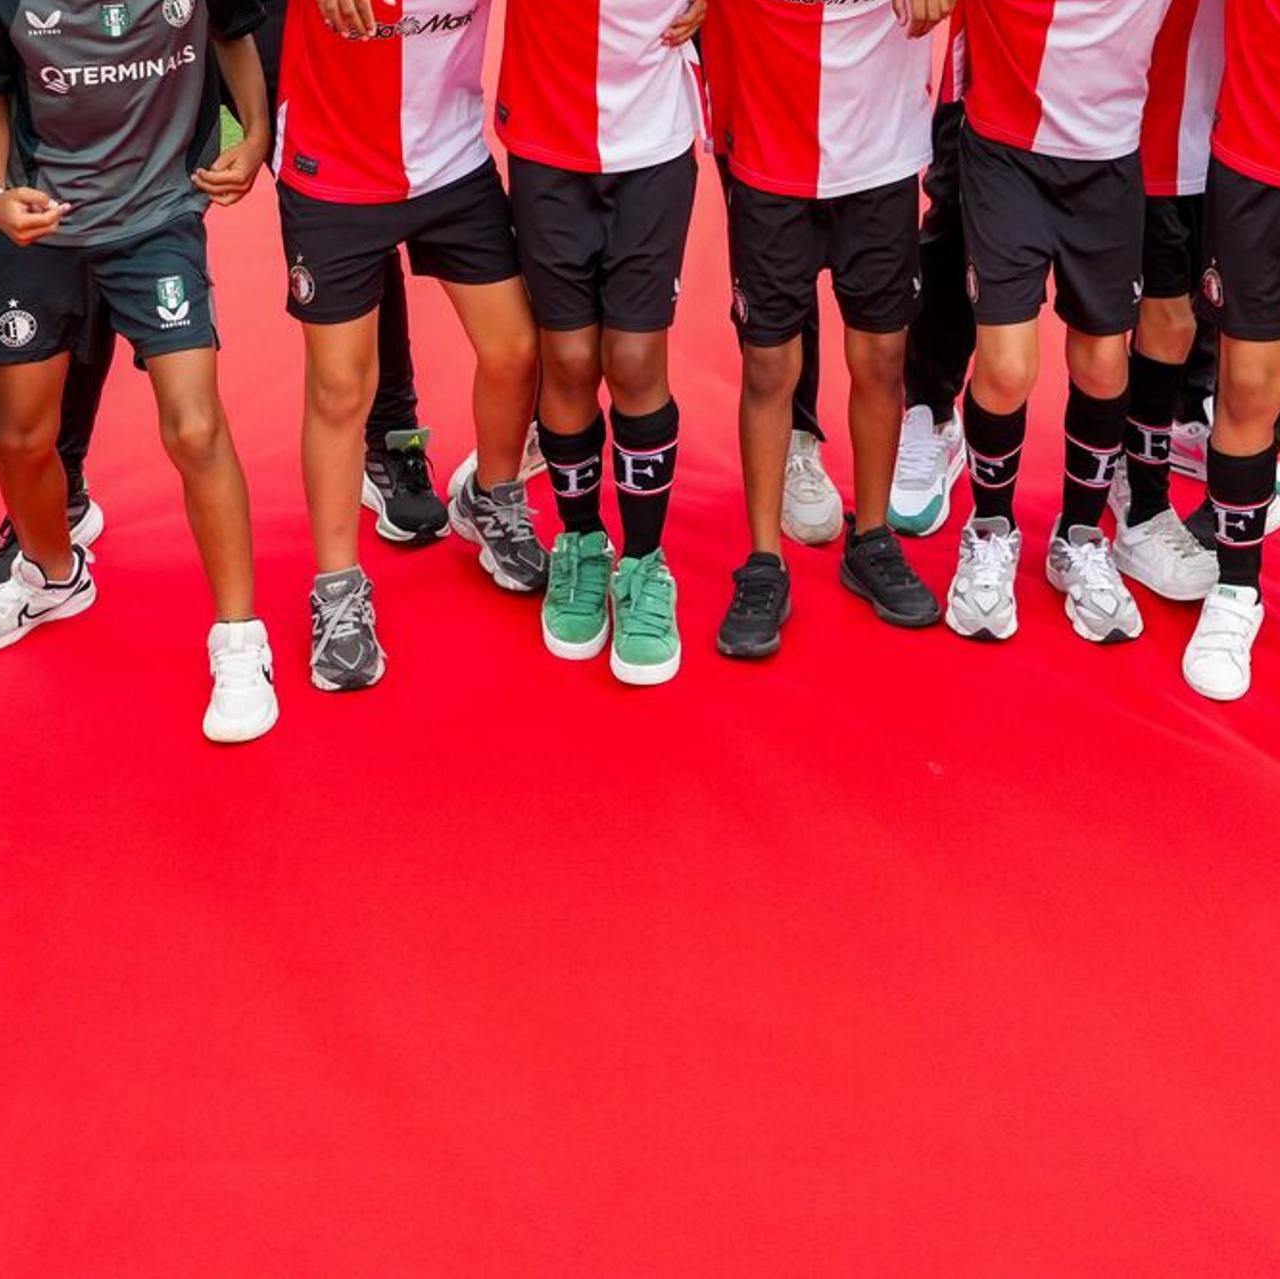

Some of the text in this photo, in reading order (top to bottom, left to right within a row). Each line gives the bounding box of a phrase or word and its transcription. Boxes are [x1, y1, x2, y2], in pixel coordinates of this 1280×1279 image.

[561, 454, 600, 494] F
[618, 451, 665, 491] F
[1215, 507, 1255, 541] F
